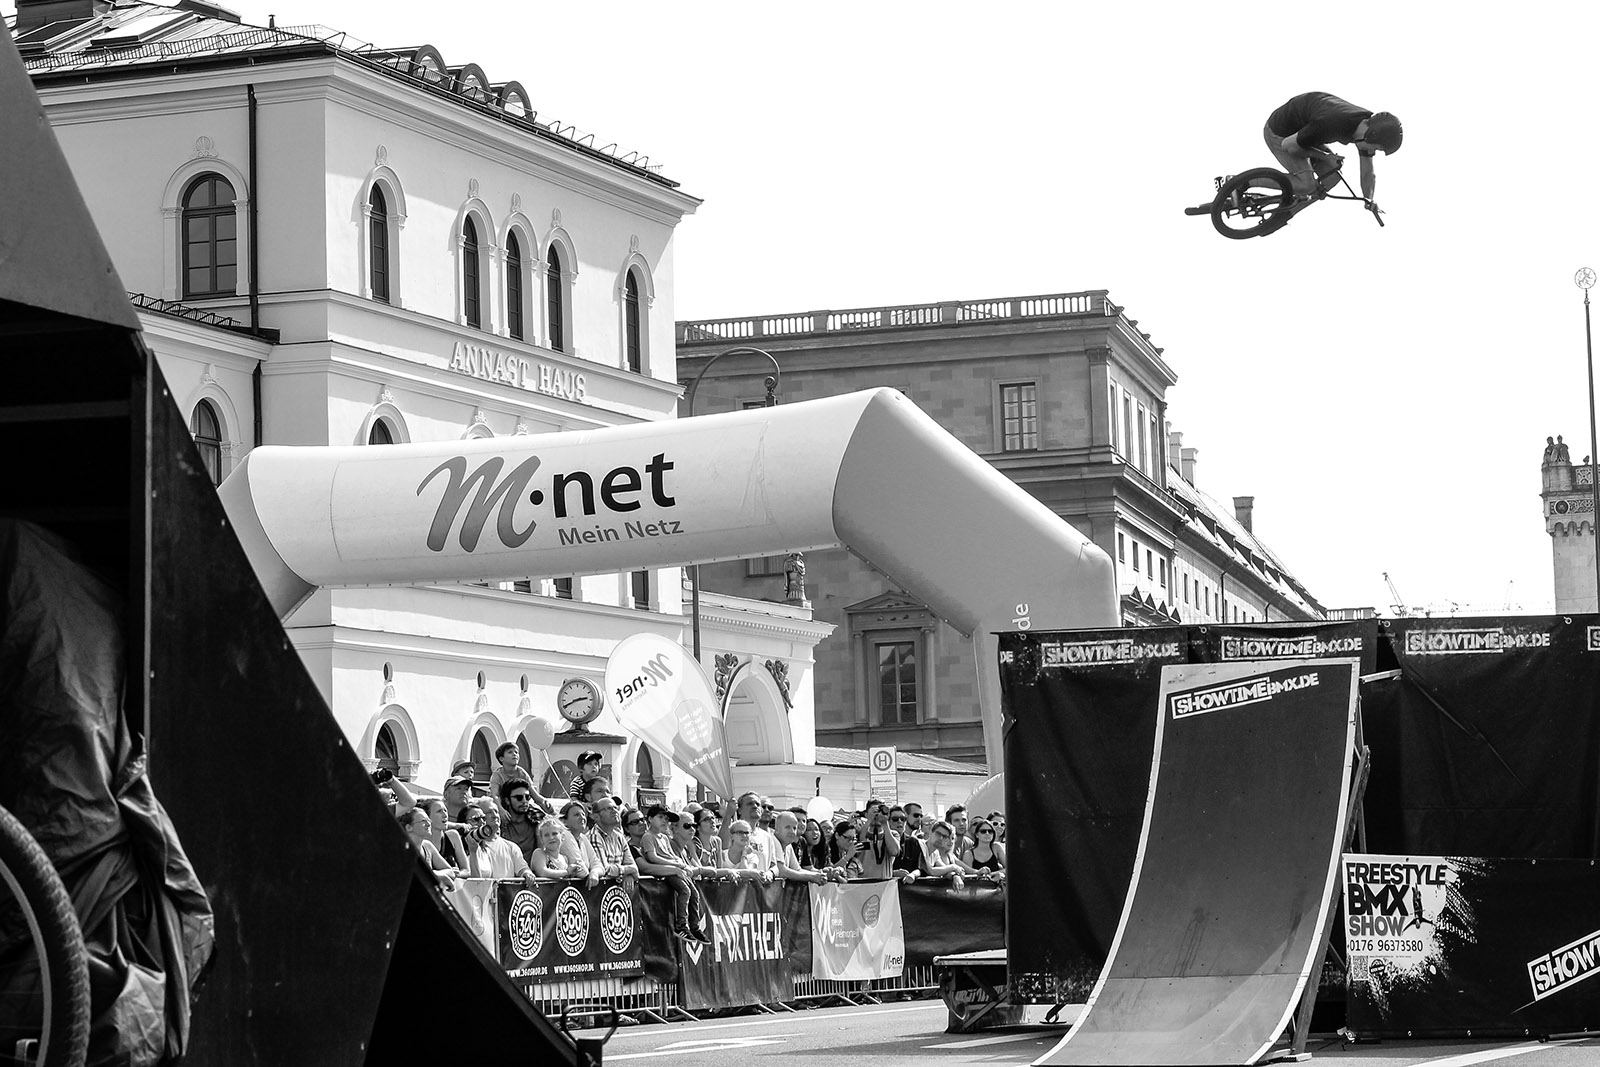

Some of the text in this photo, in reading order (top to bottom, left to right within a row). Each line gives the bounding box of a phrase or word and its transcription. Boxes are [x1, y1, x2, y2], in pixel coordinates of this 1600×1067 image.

[449, 341, 587, 402] ANNAST HAUS
[558, 519, 685, 546] Mein Netz
[1226, 637, 1362, 657] SHOWTIMEBMX.DE
[1410, 633, 1550, 651] SHOWTIMEBMX.DE
[1176, 673, 1319, 714] SHOWTIMEBMX.DE
[1346, 862, 1447, 885] FREESTYLE
[1347, 883, 1410, 916] BMX
[562, 909, 581, 933] 360
[607, 907, 627, 931] 360
[1348, 915, 1406, 937] SHOW
[1349, 939, 1423, 952] 0176 96373580
